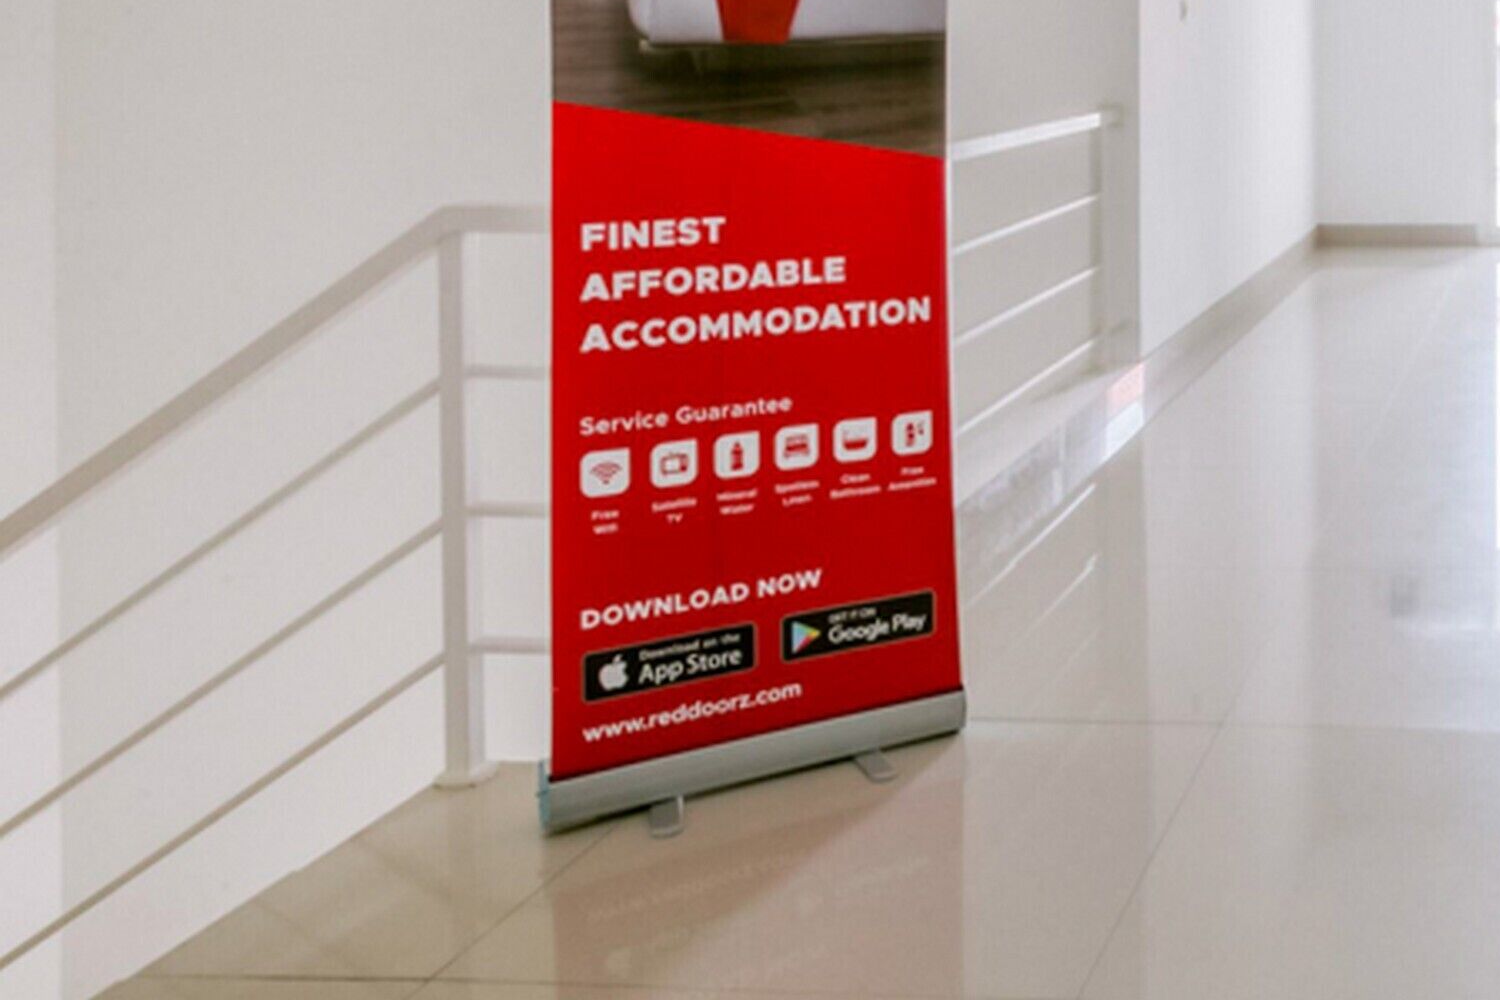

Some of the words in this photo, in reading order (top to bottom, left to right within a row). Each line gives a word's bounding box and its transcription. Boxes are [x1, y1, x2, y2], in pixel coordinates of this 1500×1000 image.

[580, 215, 726, 252] FINEST
[579, 256, 847, 303] AFFORDABLE
[579, 295, 932, 354] ACCOMMODATION
[579, 407, 669, 436] Service
[675, 396, 793, 426] Guarantee
[665, 513, 683, 524] TV
[579, 582, 750, 630] DOWNLOAD
[756, 568, 823, 599] NOW
[639, 638, 700, 661] Download
[721, 633, 741, 645] the
[827, 617, 889, 644] Google
[892, 612, 927, 632] Play
[638, 660, 684, 685] App
[685, 649, 743, 675] Store
[582, 680, 802, 742] www.reddoorz.com
